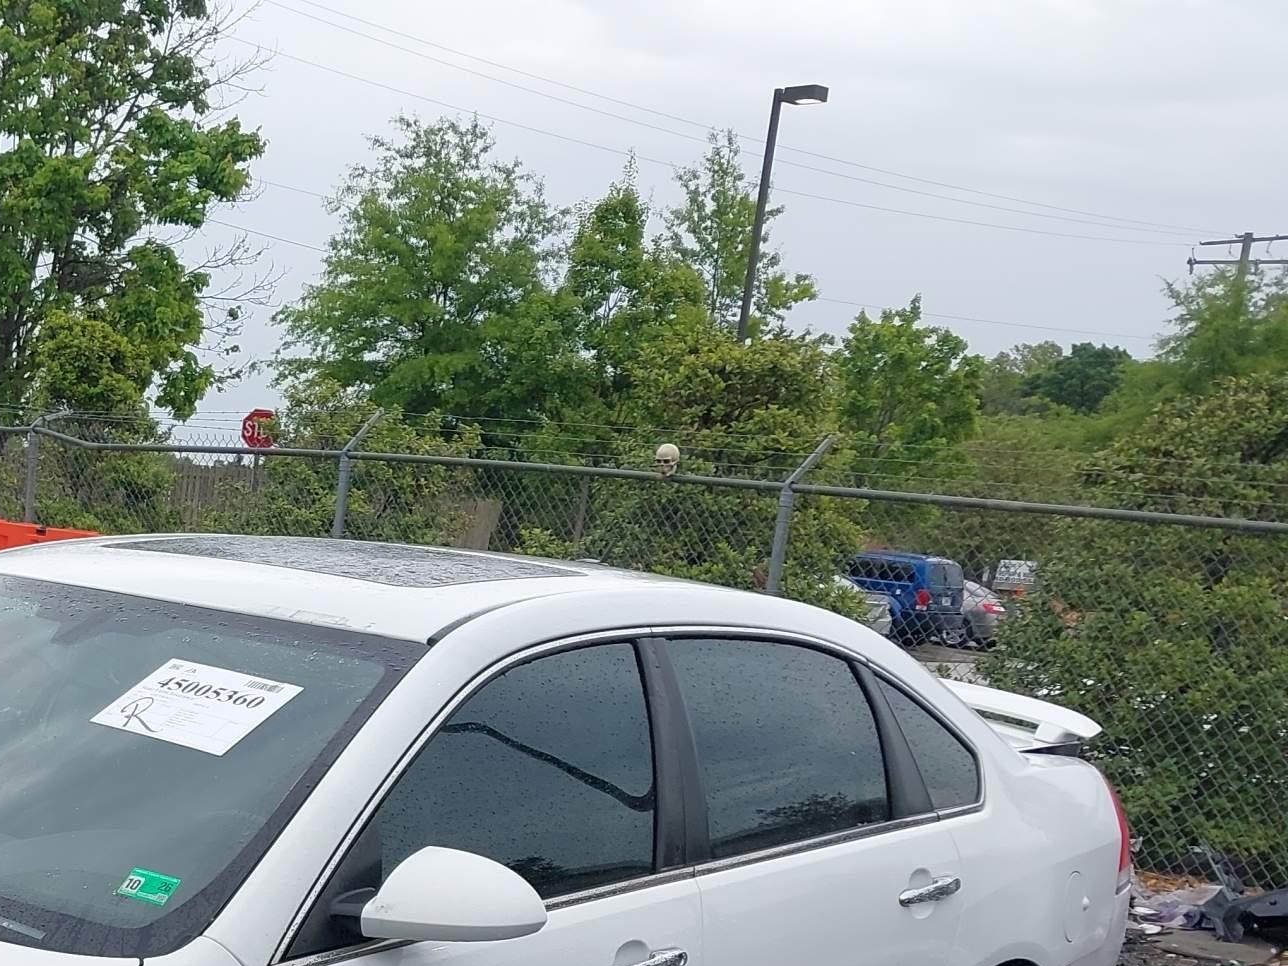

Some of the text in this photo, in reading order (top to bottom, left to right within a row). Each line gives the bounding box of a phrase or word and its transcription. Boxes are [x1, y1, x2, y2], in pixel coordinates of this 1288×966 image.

[157, 676, 266, 709] 45005360
[120, 696, 158, 733] R
[125, 878, 142, 891] 10
